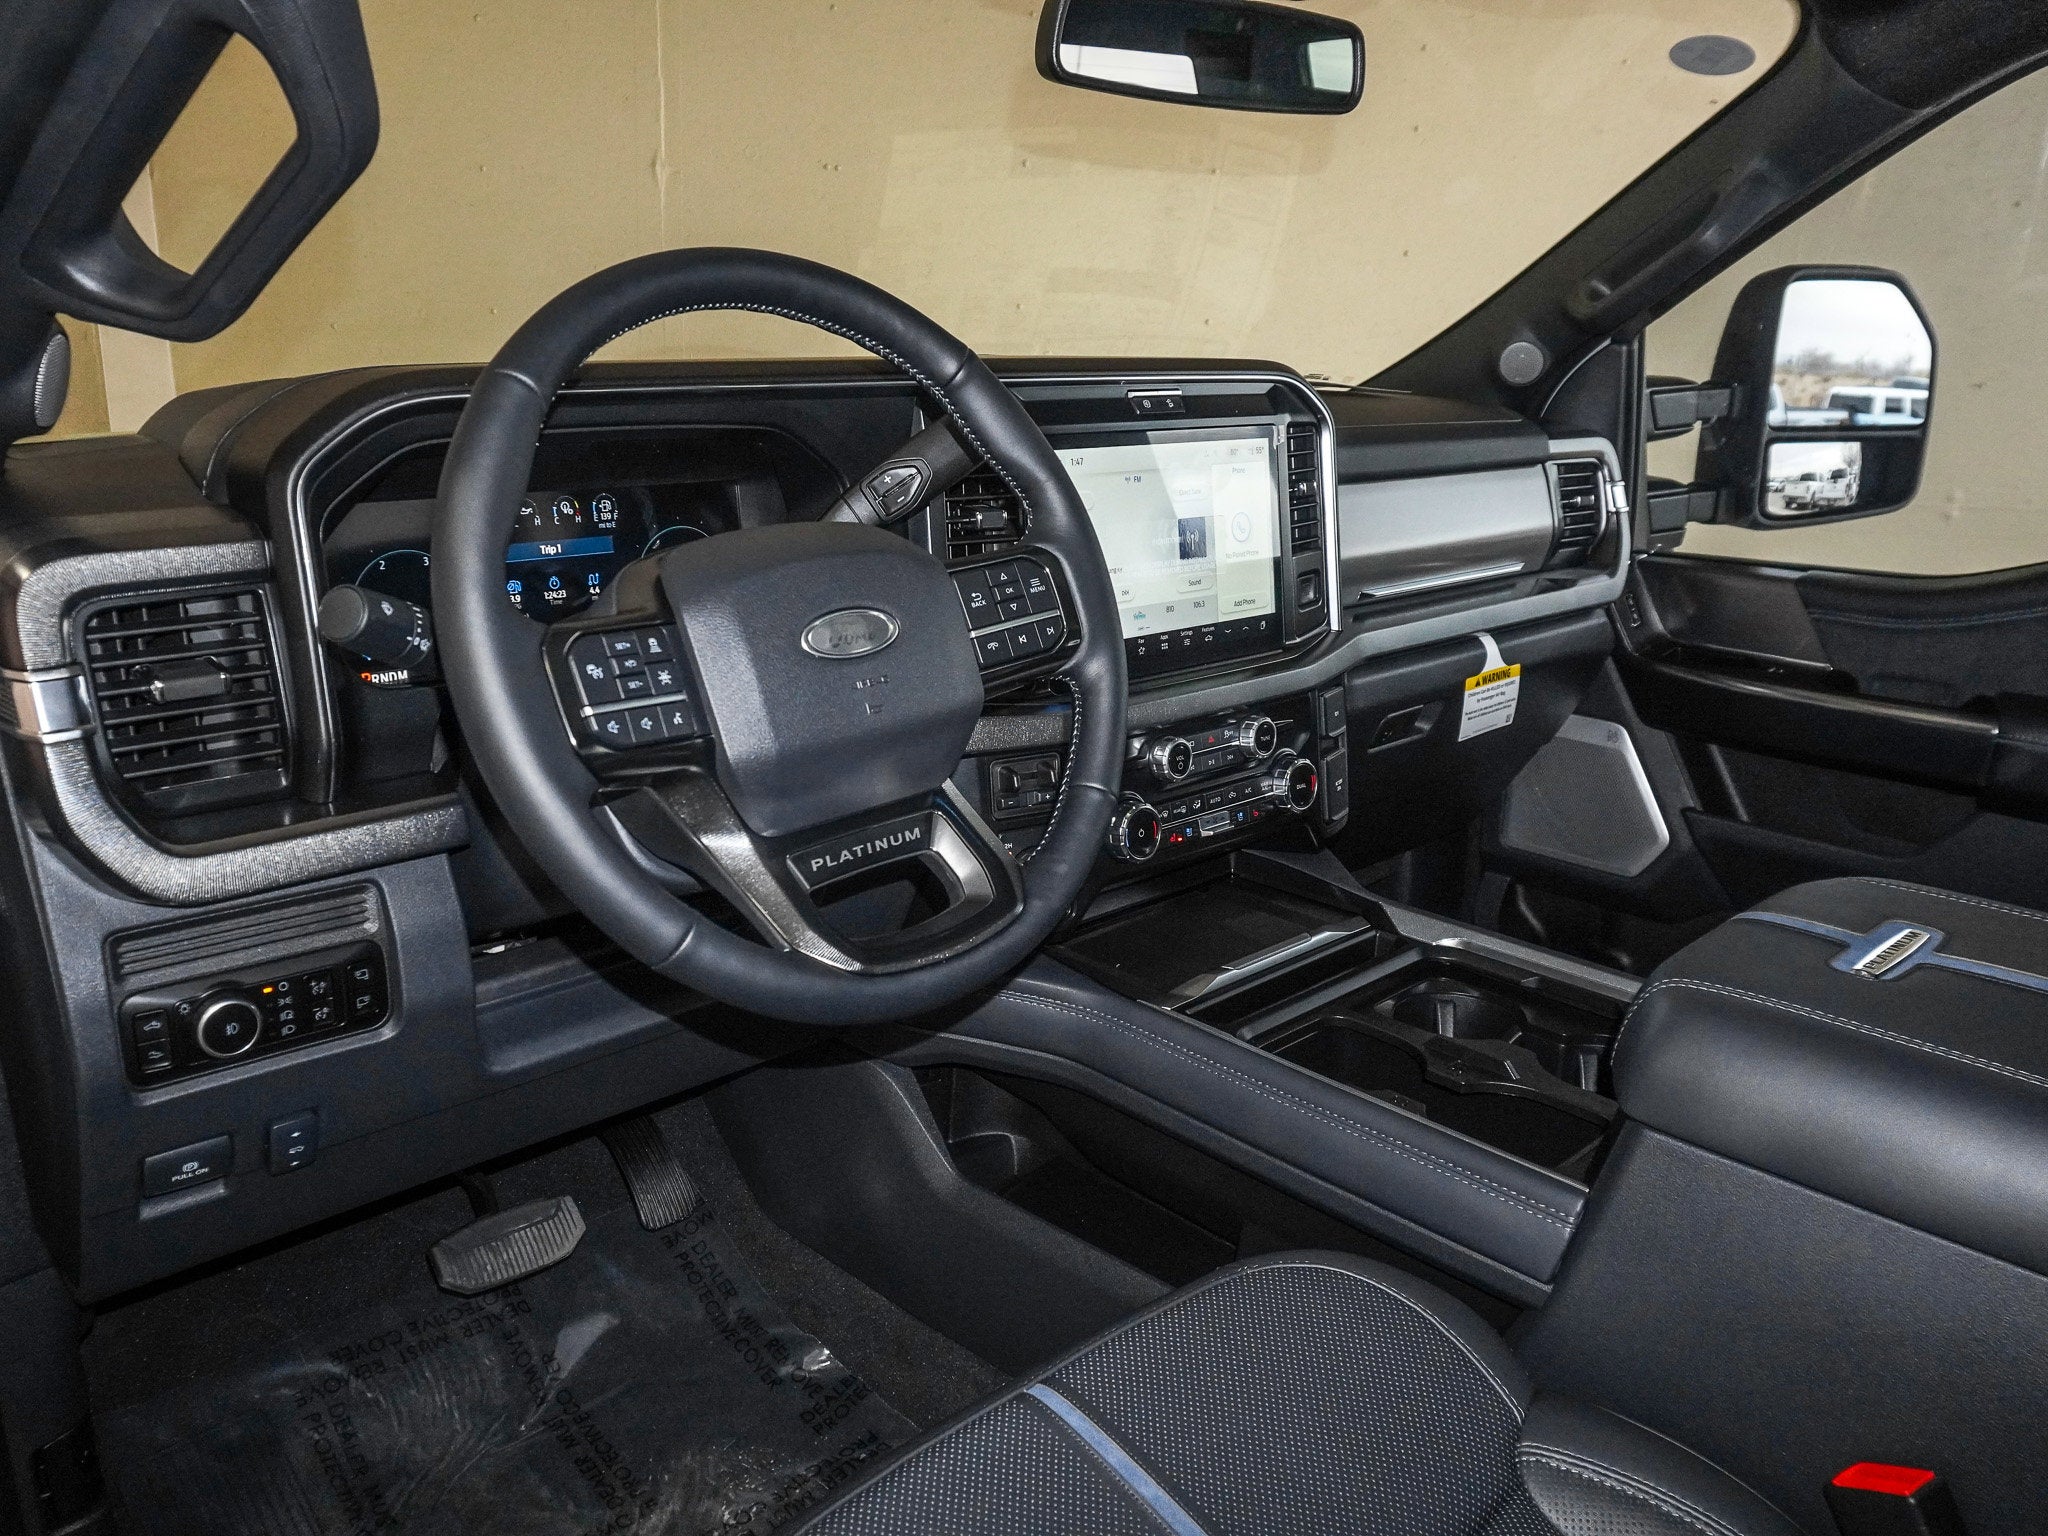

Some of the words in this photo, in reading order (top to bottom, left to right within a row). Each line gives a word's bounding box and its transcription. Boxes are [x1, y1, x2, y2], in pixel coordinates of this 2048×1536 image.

[1070, 457, 1084, 467] 1:47
[554, 517, 560, 525] C
[575, 515, 582, 523] H
[600, 512, 612, 521] 139
[534, 518, 541, 526] H
[539, 545, 557, 555] Trip
[557, 544, 562, 553] 1
[379, 560, 386, 570] 2
[423, 557, 430, 566] 3
[1188, 578, 1202, 587] Sound
[1029, 585, 1046, 594] MENU
[543, 590, 567, 600] 1:24:23
[971, 599, 987, 608] BACK
[1481, 668, 1511, 685] WARNING
[810, 827, 922, 872] PLATINUM
[1862, 930, 1923, 973] PLATINUM
[171, 1171, 194, 1182] PULL
[195, 1166, 210, 1176] ON
[691, 1239, 739, 1301] DEALER
[459, 1299, 532, 1338] DEALER
[673, 1251, 741, 1341] PROTECTIVE
[733, 1337, 784, 1391] COVER
